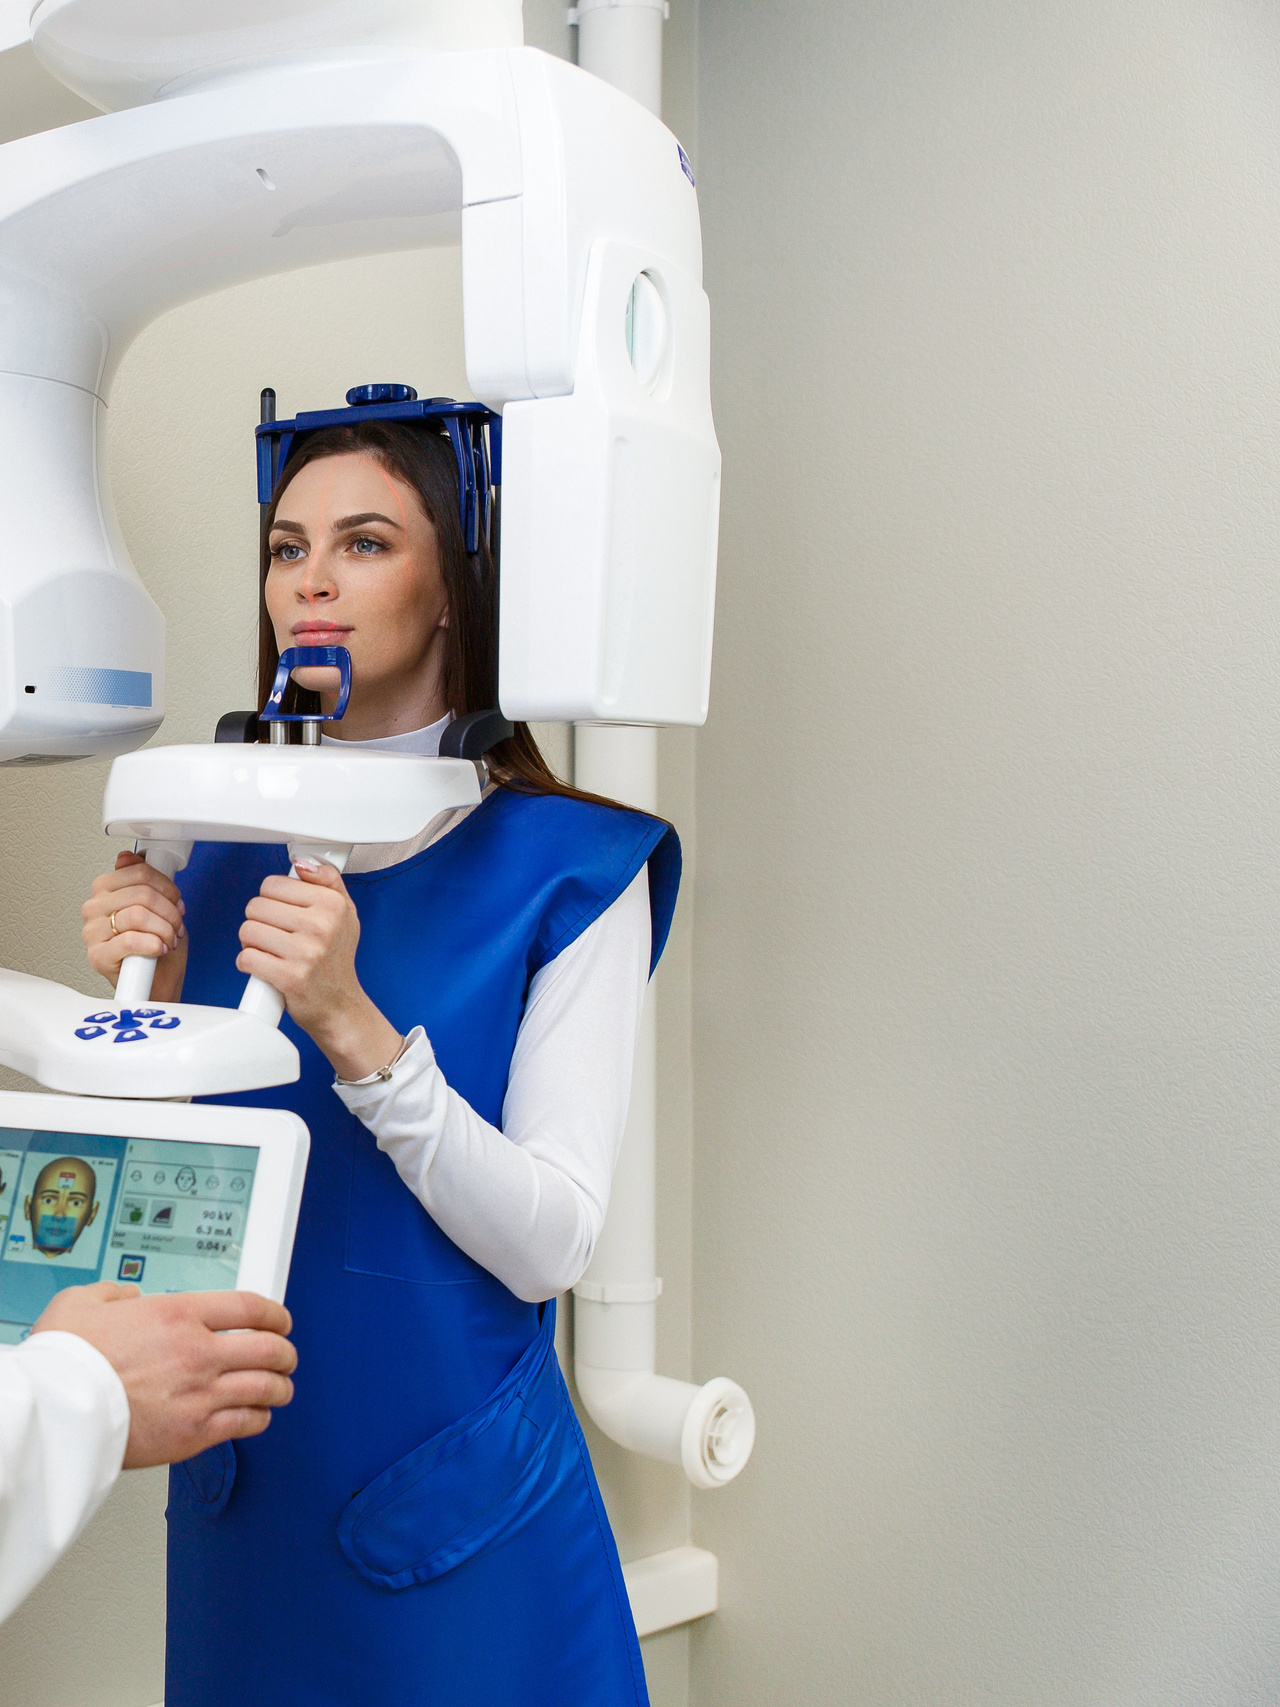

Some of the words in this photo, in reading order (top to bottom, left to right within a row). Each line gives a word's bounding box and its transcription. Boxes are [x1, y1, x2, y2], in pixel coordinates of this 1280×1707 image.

[202, 1209, 216, 1219] 90
[218, 1210, 233, 1222] kV
[196, 1224, 213, 1236] 6.3
[214, 1226, 233, 1237] mA
[196, 1239, 221, 1252] 0.04
